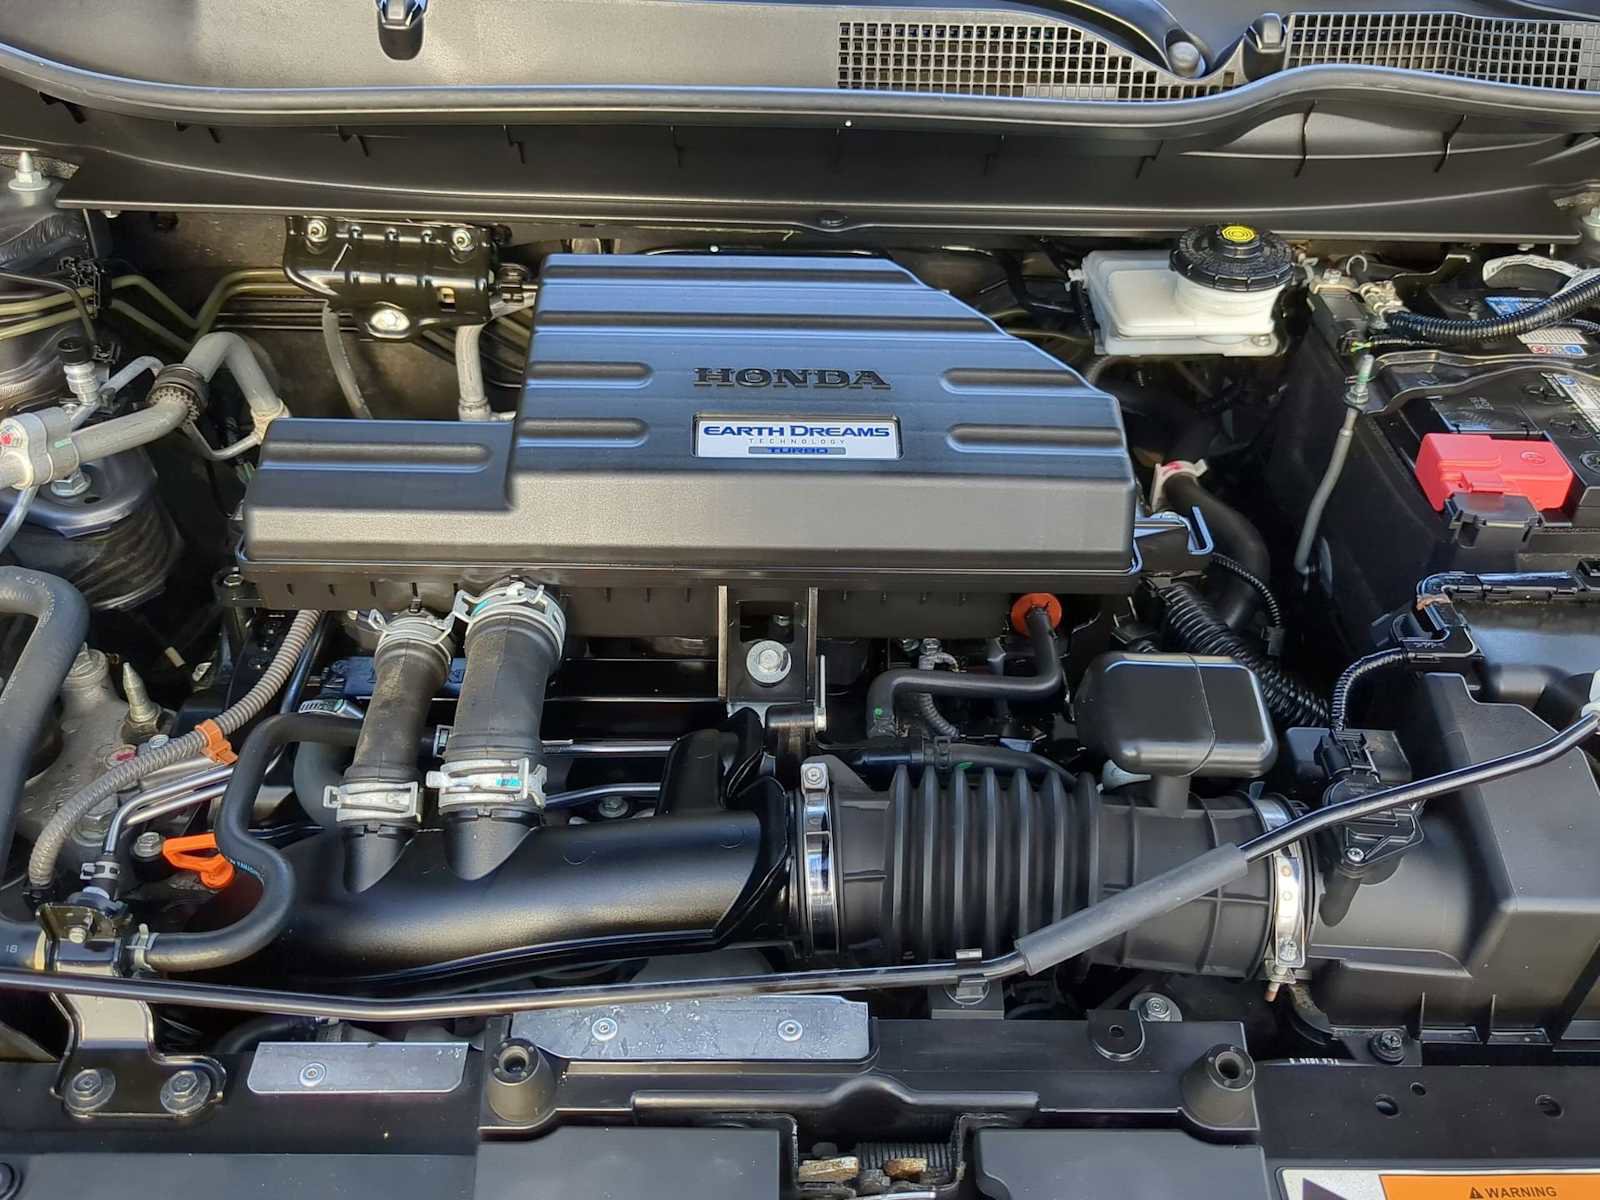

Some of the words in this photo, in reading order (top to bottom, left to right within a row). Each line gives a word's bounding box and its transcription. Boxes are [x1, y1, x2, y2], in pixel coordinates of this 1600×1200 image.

[694, 367, 892, 390] HONDA
[703, 425, 785, 437] EARTH
[790, 425, 891, 438] DREAMS
[767, 446, 829, 454] TURBO
[1484, 1186, 1557, 1199] WARNING
